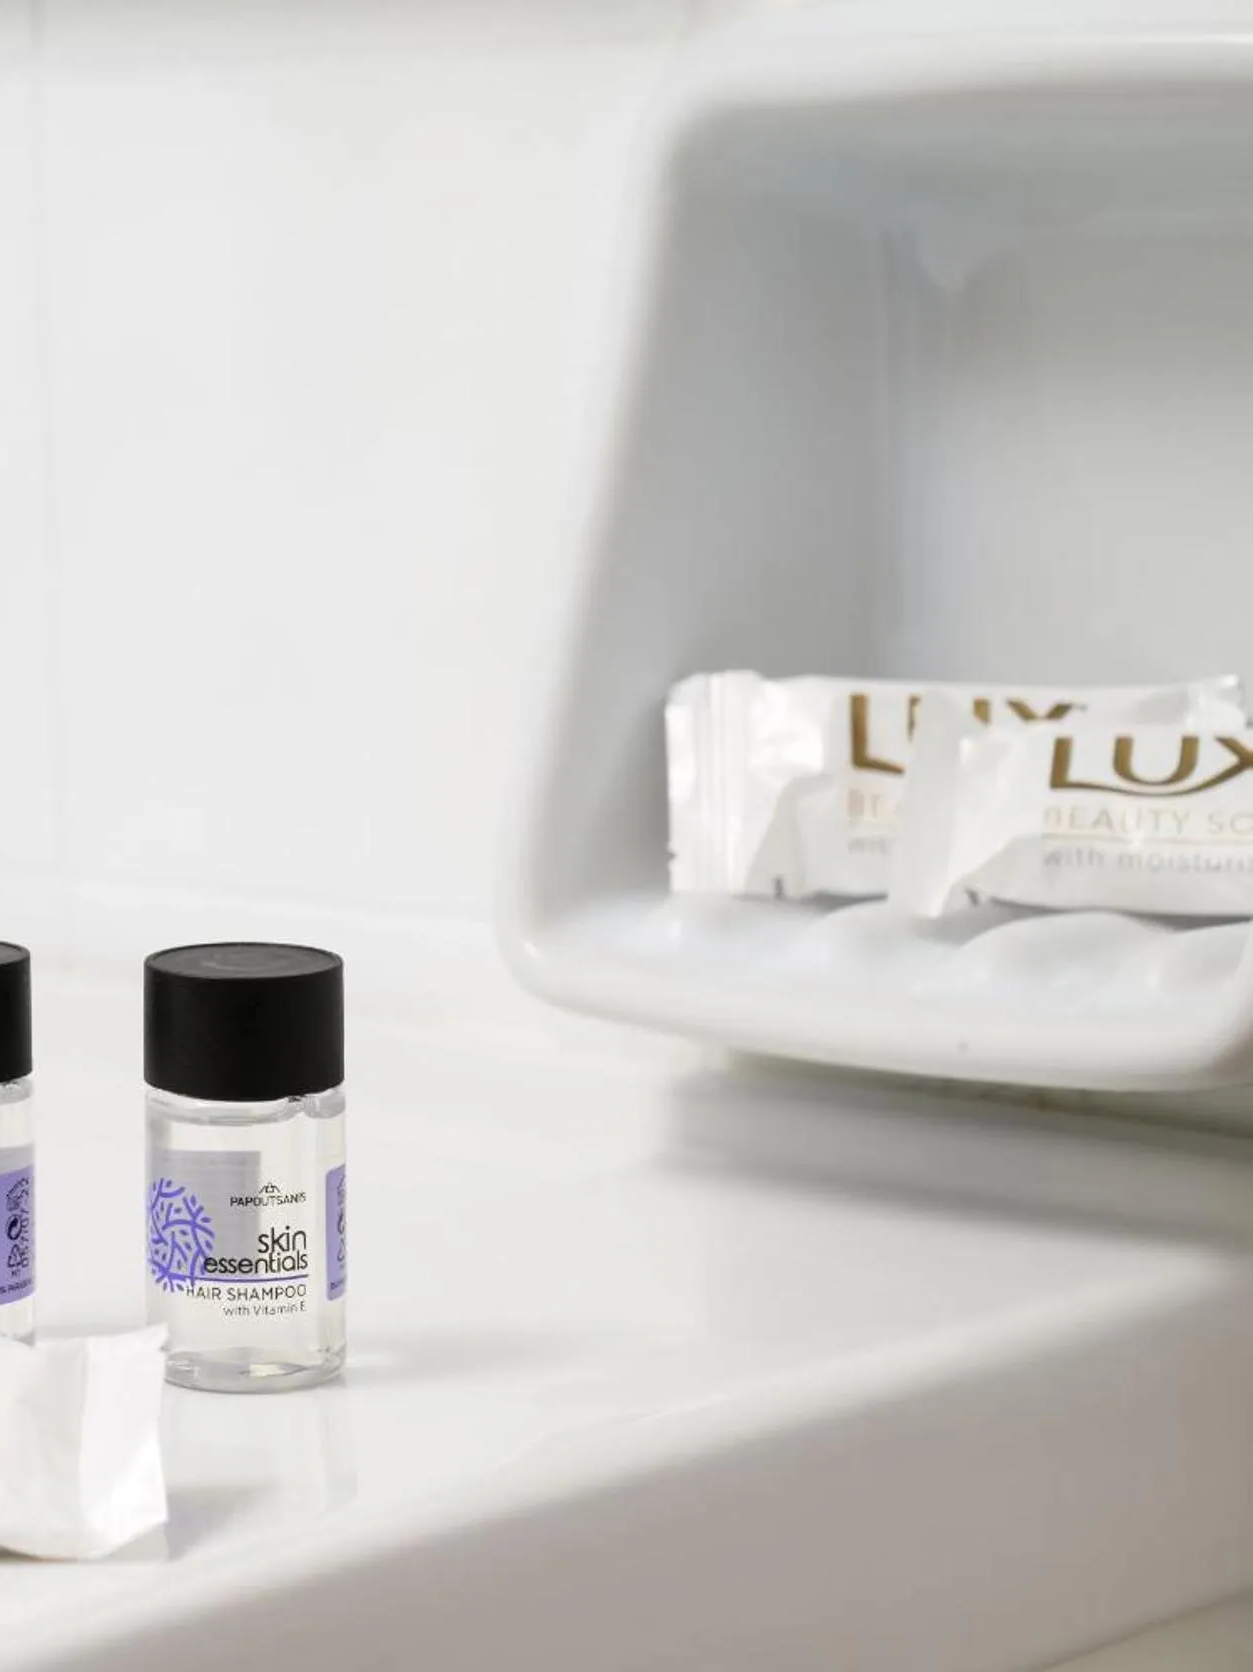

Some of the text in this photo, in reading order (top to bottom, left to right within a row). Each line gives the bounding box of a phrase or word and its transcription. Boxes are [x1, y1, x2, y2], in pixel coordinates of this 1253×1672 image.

[1118, 850, 1253, 875] moisturi
[230, 1192, 306, 1207] PAPOUTSANIS
[257, 1225, 307, 1253] skin
[203, 1250, 309, 1274] essentials
[186, 1284, 307, 1301] HAIR SHAMPOO
[223, 1301, 306, 1317] with Vitamin E
